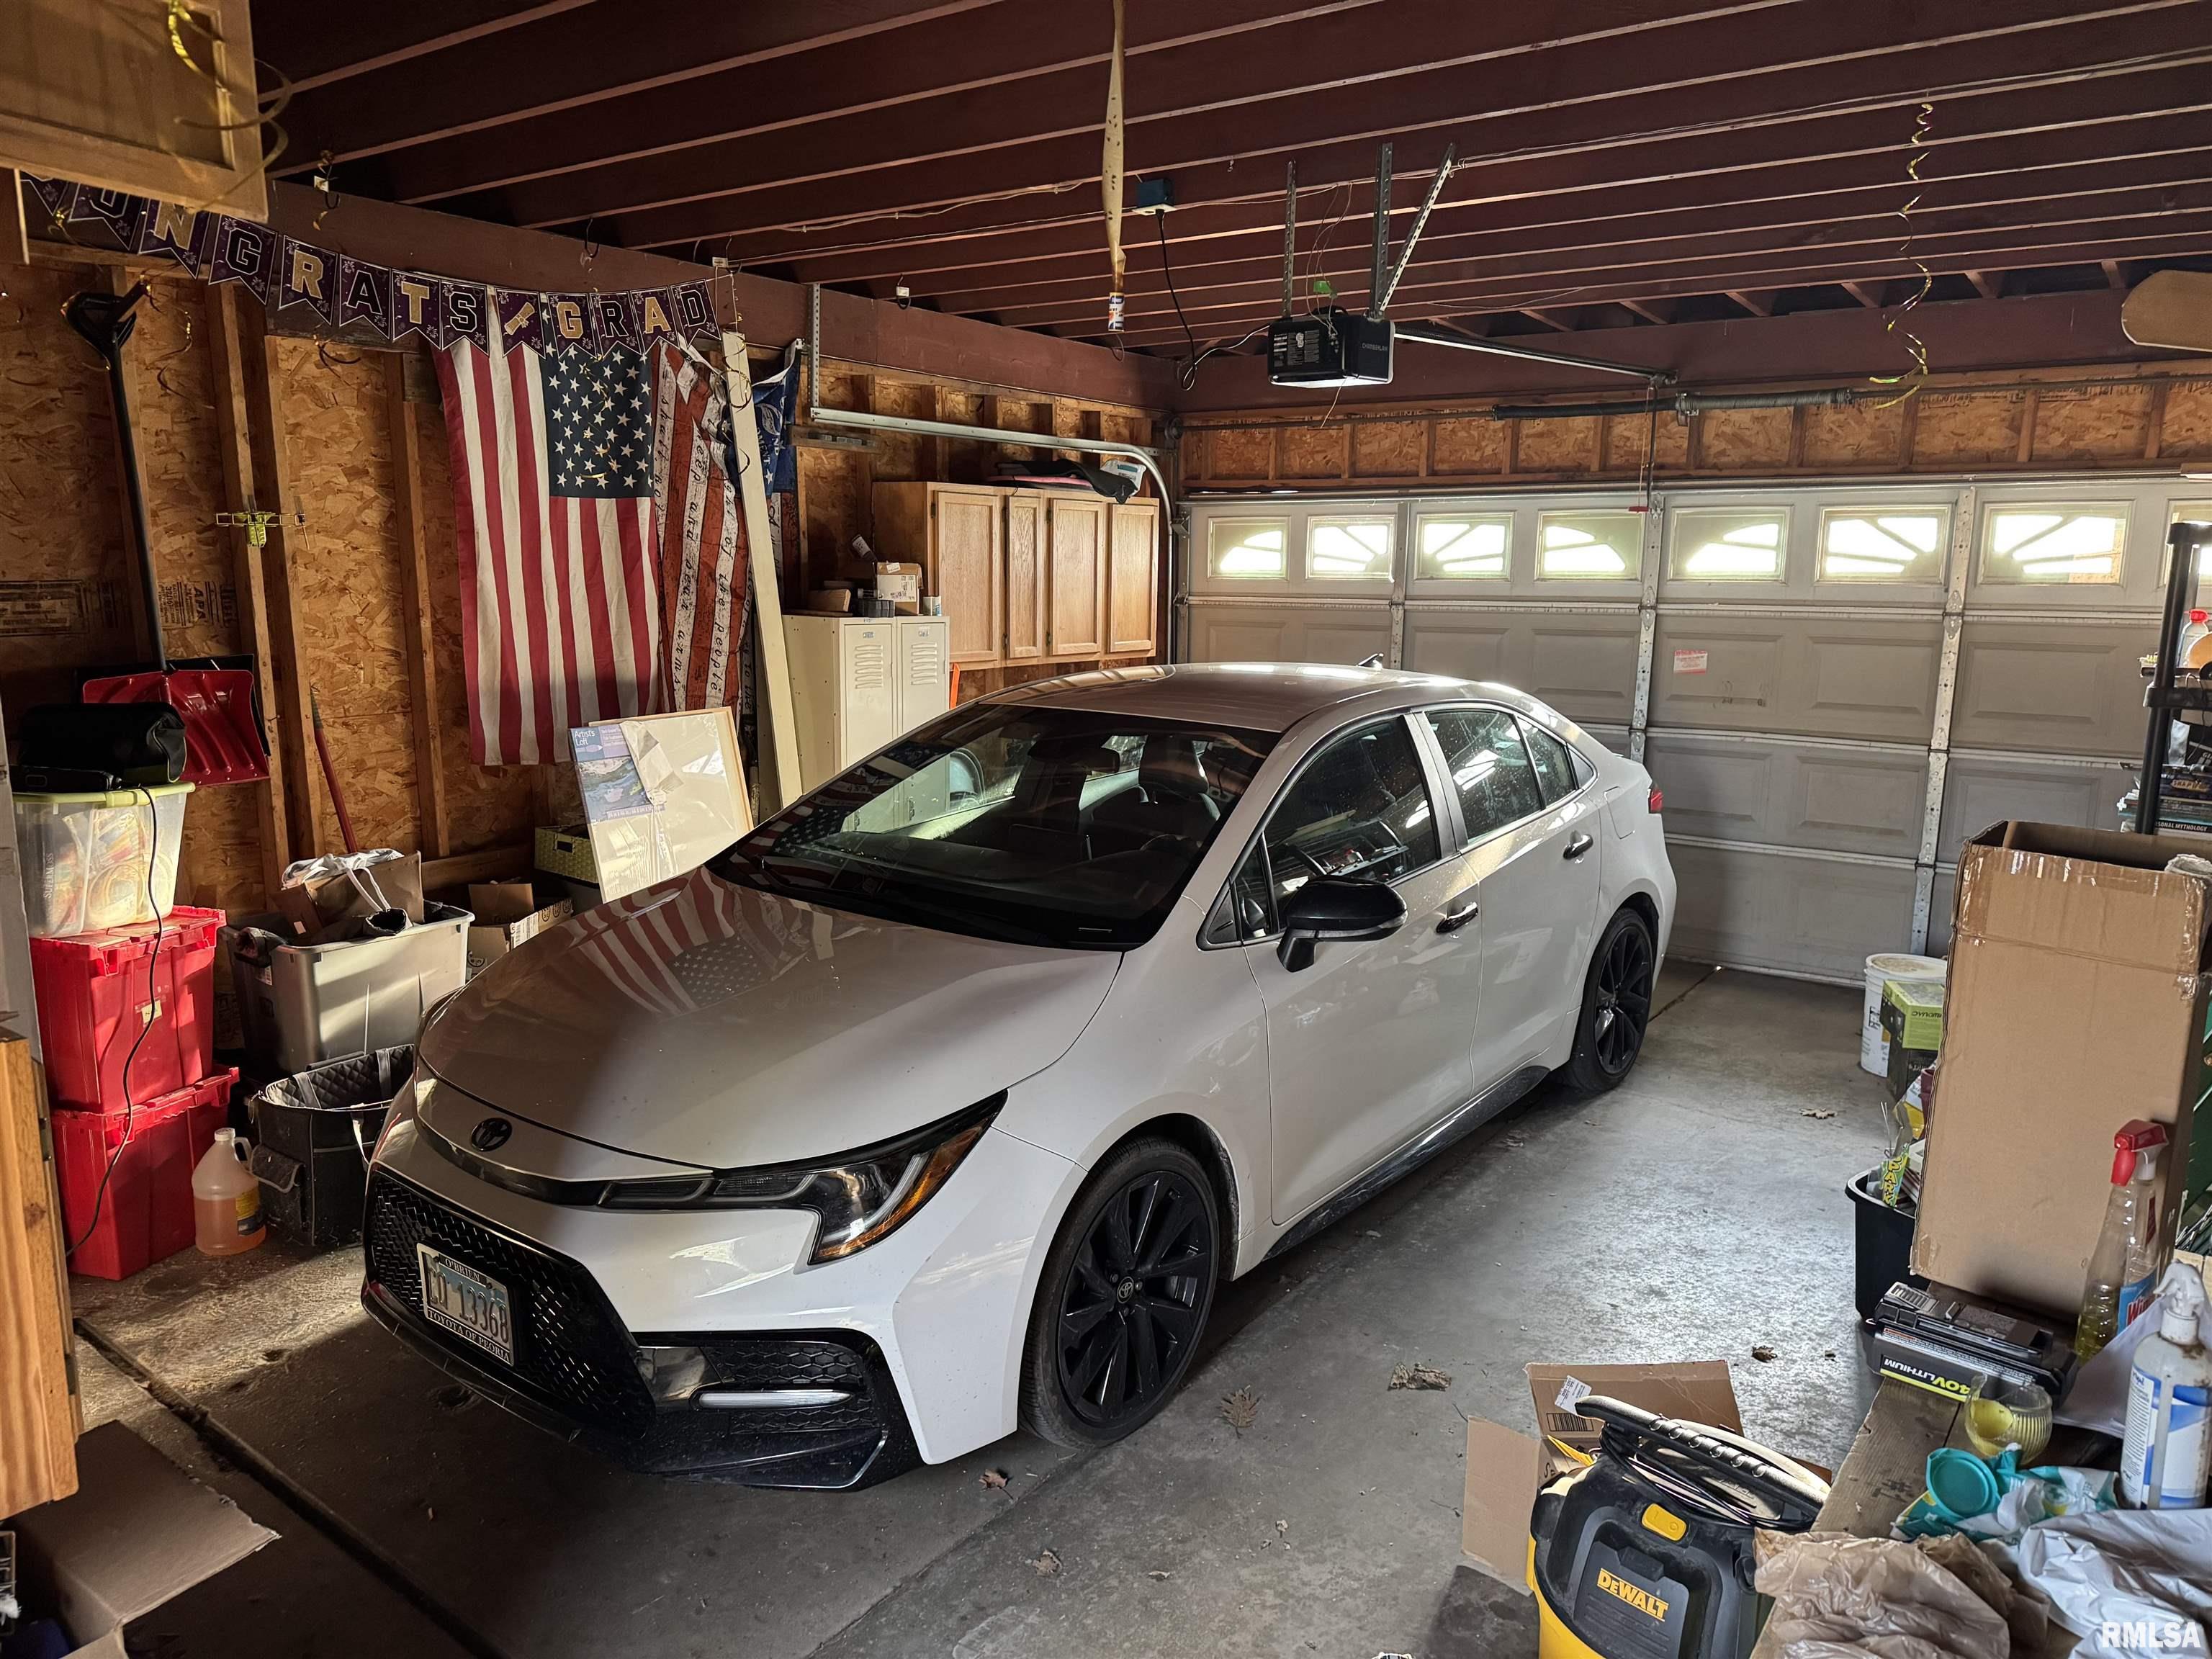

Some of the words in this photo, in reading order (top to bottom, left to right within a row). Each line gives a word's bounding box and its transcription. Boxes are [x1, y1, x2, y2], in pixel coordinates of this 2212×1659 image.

[24, 170, 478, 333] ONGRATS
[556, 289, 708, 340] GRAD
[718, 574, 729, 608] the
[709, 622, 724, 691] people
[574, 729, 595, 738] Artist's
[2155, 821, 2175, 830] SONAL
[2175, 822, 2208, 832] MYTHOLOGY
[445, 1258, 480, 1282] O'BRIEN
[458, 1281, 509, 1344] 13368
[428, 1310, 464, 1335] TOYOTA
[464, 1329, 477, 1341] OF
[479, 1337, 510, 1362] PEORIA
